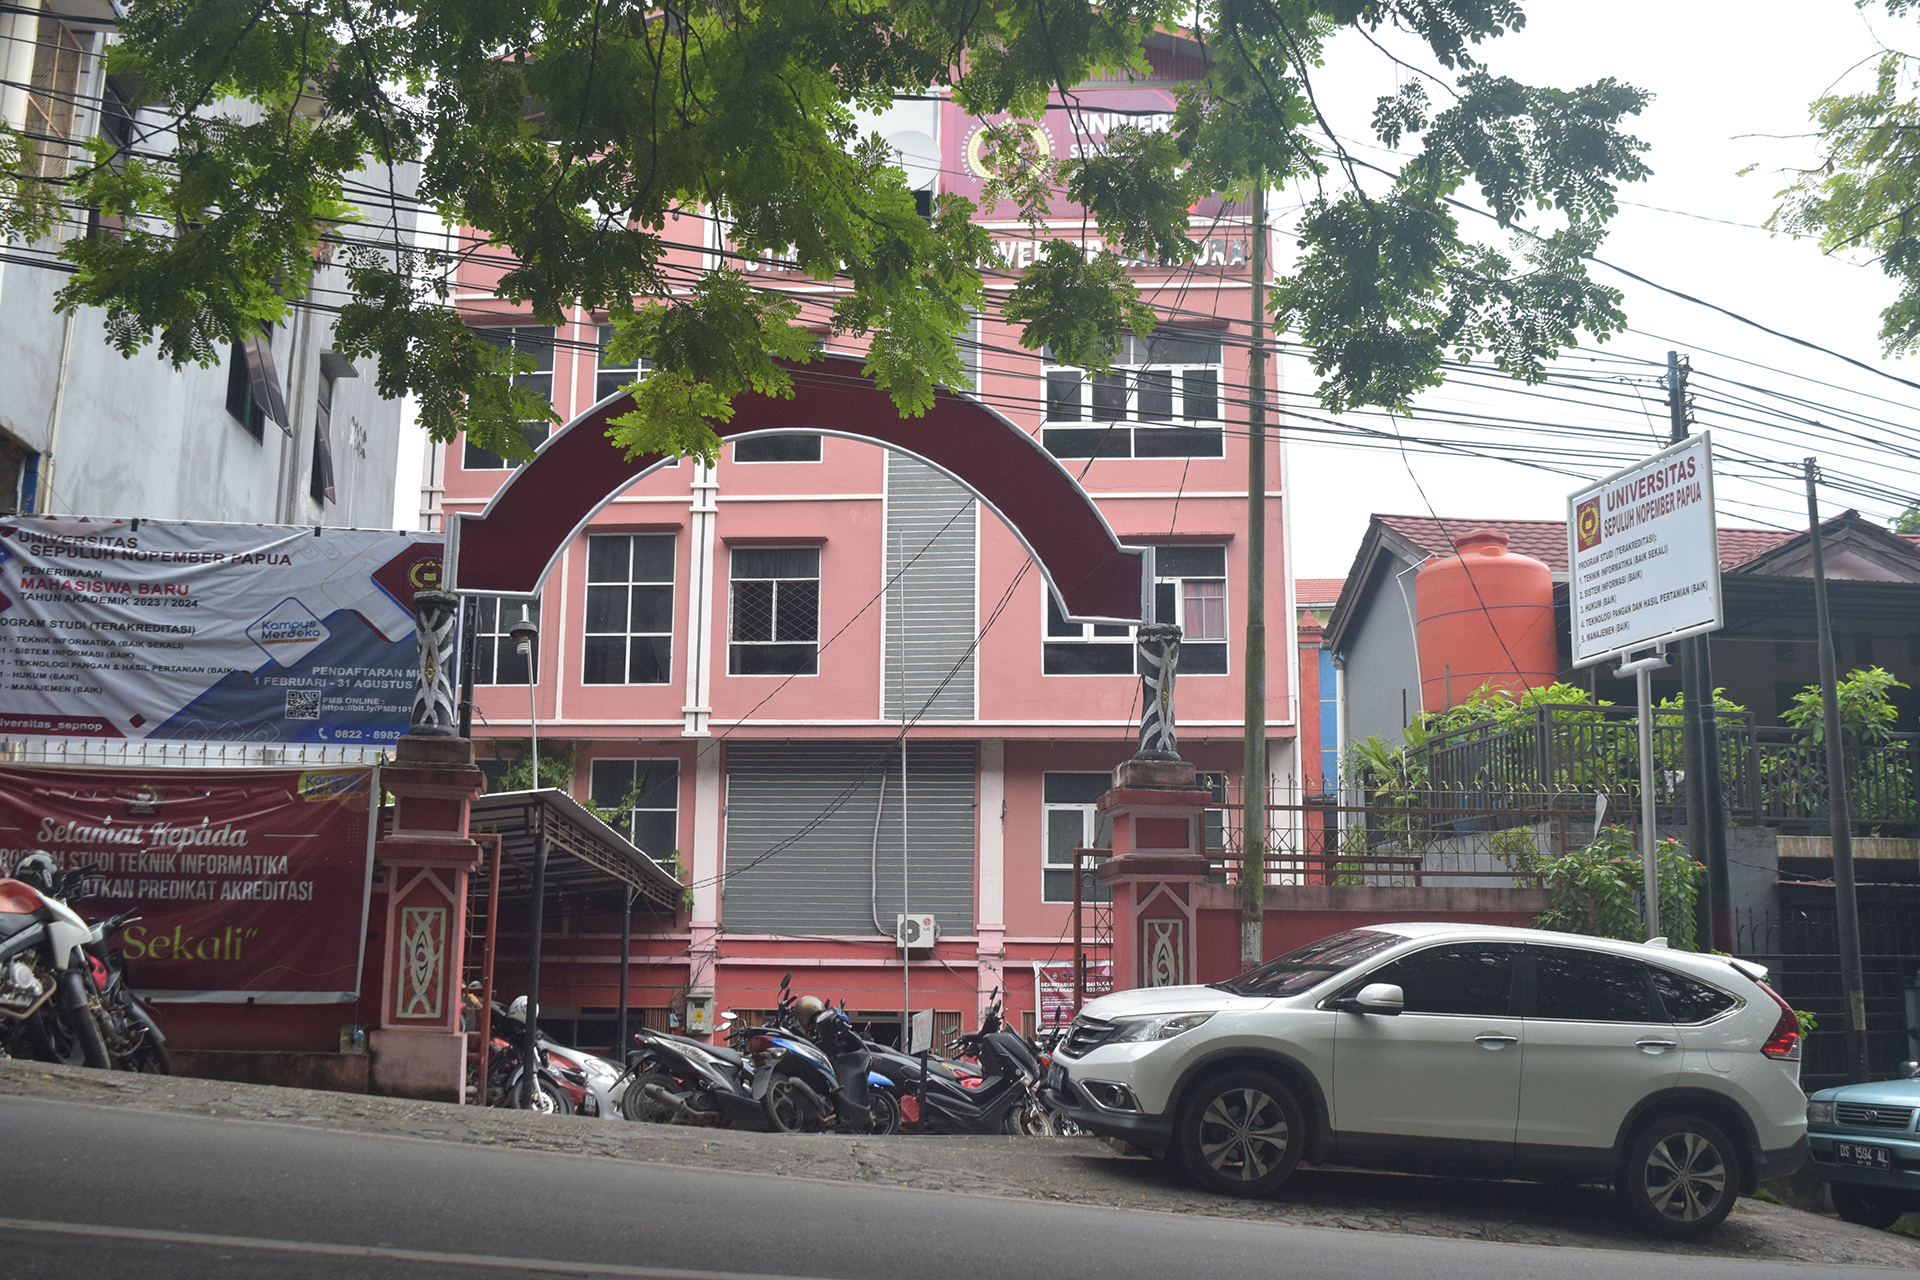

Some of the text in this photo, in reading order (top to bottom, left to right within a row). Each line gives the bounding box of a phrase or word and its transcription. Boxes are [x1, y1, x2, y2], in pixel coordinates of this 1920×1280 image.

[1069, 113, 1174, 135] UNIVER
[1606, 456, 1696, 512] UNIVERSITAS
[1603, 508, 1635, 539] SEPULUH
[1636, 492, 1675, 526] NOPEMBER
[1676, 481, 1702, 510] PAPUA
[18, 531, 138, 549] UNIVERSITAS
[30, 544, 292, 566] SEPULUH NOPEMBER PAPUA
[1578, 555, 1600, 571] PROGRAM
[1600, 549, 1614, 562] STUDI
[1583, 569, 1600, 584] TEKNIK
[1601, 558, 1633, 577] INFORMATIKA
[1634, 552, 1647, 566] (BAIK
[1648, 544, 1668, 560] SEKALI)
[22, 566, 103, 578] PENERIMAAN
[20, 577, 189, 596] MAHASISWA BARU
[1584, 584, 1601, 598] SISTEM
[1601, 575, 1626, 592] INFORMASI
[1627, 569, 1642, 584] (BAIK)
[20, 592, 61, 603] TAHUN
[64, 593, 130, 606] AKADEMIK
[133, 597, 160, 607] 2023
[171, 598, 199, 608] 2024
[1585, 599, 1601, 612] HUKUM
[1603, 594, 1616, 608] (BAIK)
[1586, 611, 1611, 627] TEKNOLOGI
[1612, 604, 1631, 619] PANGAN
[1632, 600, 1643, 612] DAN
[1643, 596, 1659, 609] HASIL
[1660, 586, 1690, 603] PERTANIAN
[1691, 580, 1709, 595] (BAIK)
[0, 618, 196, 636] OGRAM STUDI (TERAKREDITASI)
[262, 620, 317, 631] Kampus
[262, 629, 320, 640] Merdeka
[1586, 626, 1614, 641] MANAJEMEN
[1616, 620, 1630, 634] (BAIK)
[16, 635, 51, 644] TEKNIK
[53, 637, 116, 647] INFORMATIKA
[119, 639, 144, 649] (BAIK
[147, 641, 184, 650] SEKALI)
[14, 648, 49, 656] SISTEM
[52, 649, 104, 658] INFORMASI
[107, 650, 135, 660] (BAIK)
[12, 671, 47, 679] HUKUM
[50, 673, 79, 681] (BAIK)
[14, 659, 69, 668] TEKNOLOGI
[71, 661, 110, 670] PANGAN
[152, 665, 205, 673] PERTANIAN
[207, 666, 236, 676] (BAIK)
[312, 666, 402, 678] PENDAFTARAN
[11, 683, 71, 692] MANAJEMEN
[73, 686, 103, 695] (BAIK)
[254, 676, 260, 686] 1
[264, 676, 327, 687] FEBRUARI
[337, 679, 350, 688] 31
[354, 679, 413, 689] AGUSTUS
[321, 703, 413, 713] https://bit.ly/PMB101
[345, 697, 380, 705] ONLINE
[0, 718, 103, 732] iversitas_sepnop
[335, 729, 362, 739] 0822
[373, 730, 401, 739] 8982
[37, 817, 249, 853] Selamat Kepada
[69, 851, 114, 872] STUDI
[120, 852, 177, 873] TEKNIK
[180, 853, 288, 875] INFORMATIKA
[139, 879, 217, 900] PREDIKAT
[220, 880, 313, 901] AKREDITASI
[1840, 1144, 1850, 1157] DS
[1855, 1146, 1872, 1160] 1594
[1877, 1149, 1888, 1163] AL
